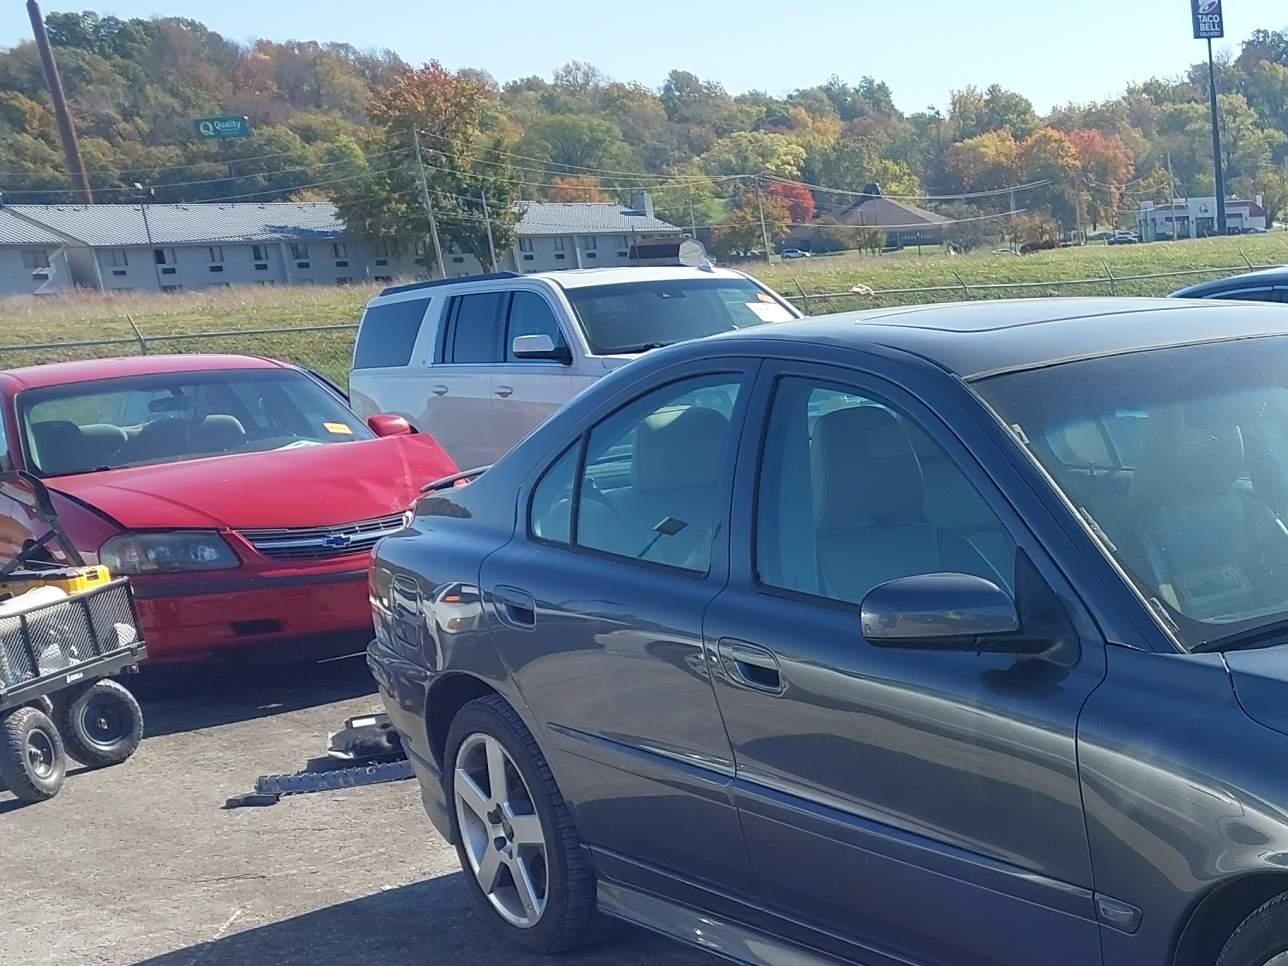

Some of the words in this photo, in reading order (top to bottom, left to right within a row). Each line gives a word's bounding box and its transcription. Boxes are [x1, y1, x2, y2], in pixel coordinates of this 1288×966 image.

[1197, 14, 1220, 23] TACO
[1199, 23, 1221, 31] BELL
[214, 120, 241, 130] Quality
